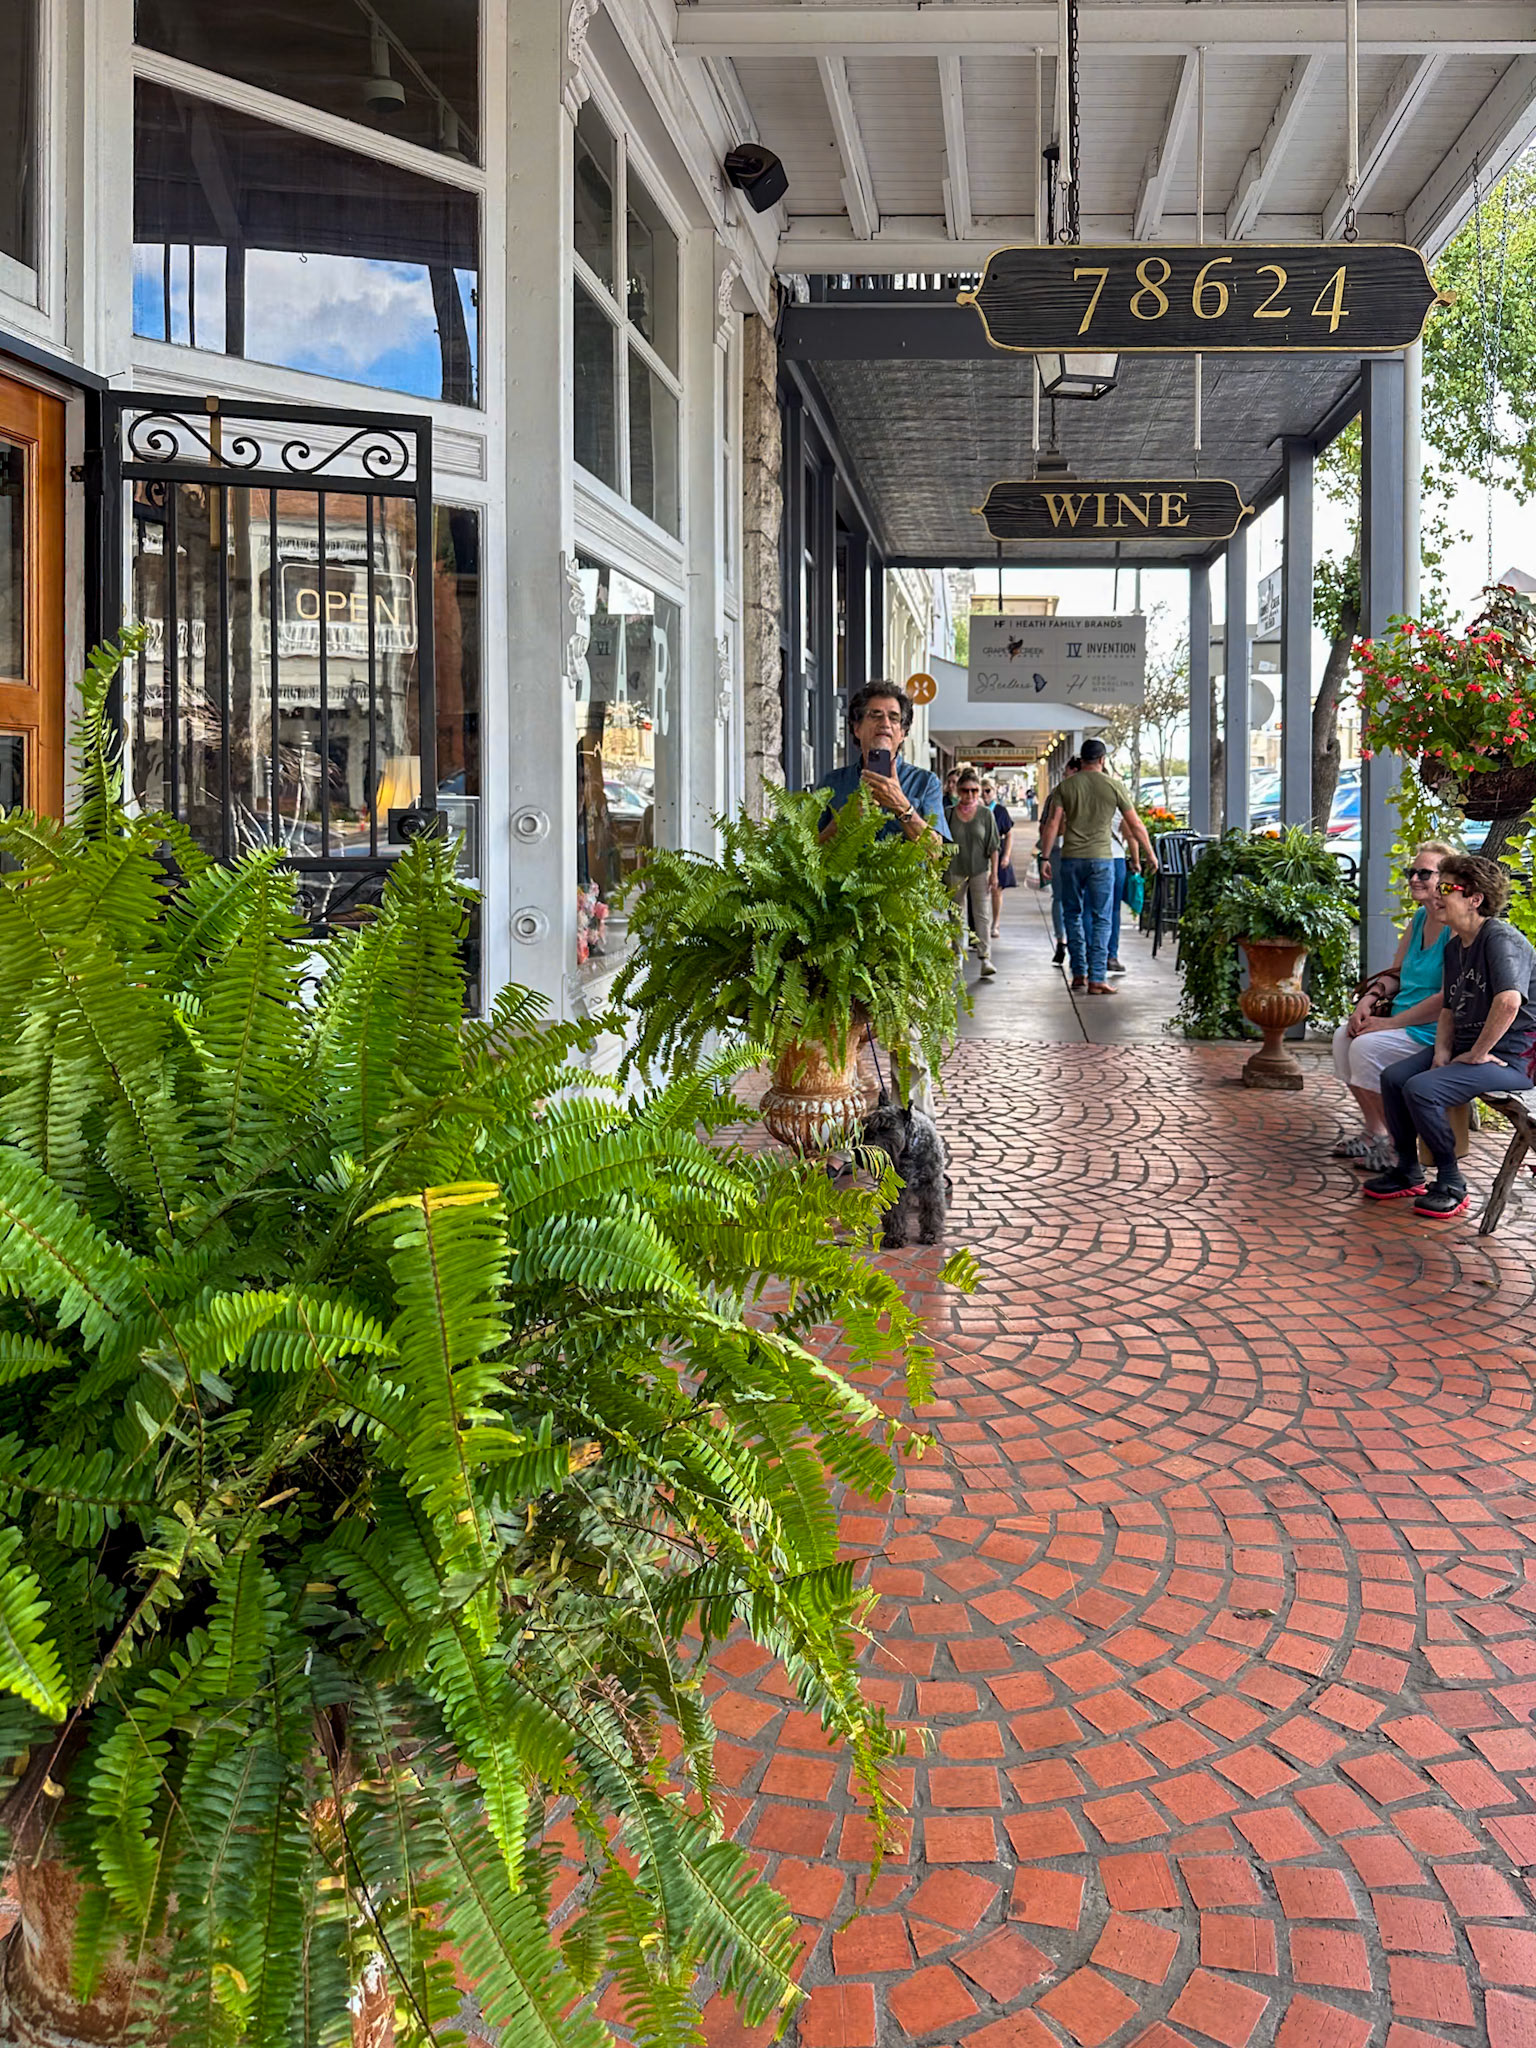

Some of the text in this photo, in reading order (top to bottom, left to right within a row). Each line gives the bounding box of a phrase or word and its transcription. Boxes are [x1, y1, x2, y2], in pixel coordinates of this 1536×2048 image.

[1073, 256, 1350, 336] 78624
[1040, 492, 1191, 529] WINE
[296, 588, 400, 628] OPEN
[993, 620, 1123, 628] HF HEATH FAMILY BRANDS
[1065, 642, 1083, 658] IV
[1087, 642, 1136, 654] INVENTION
